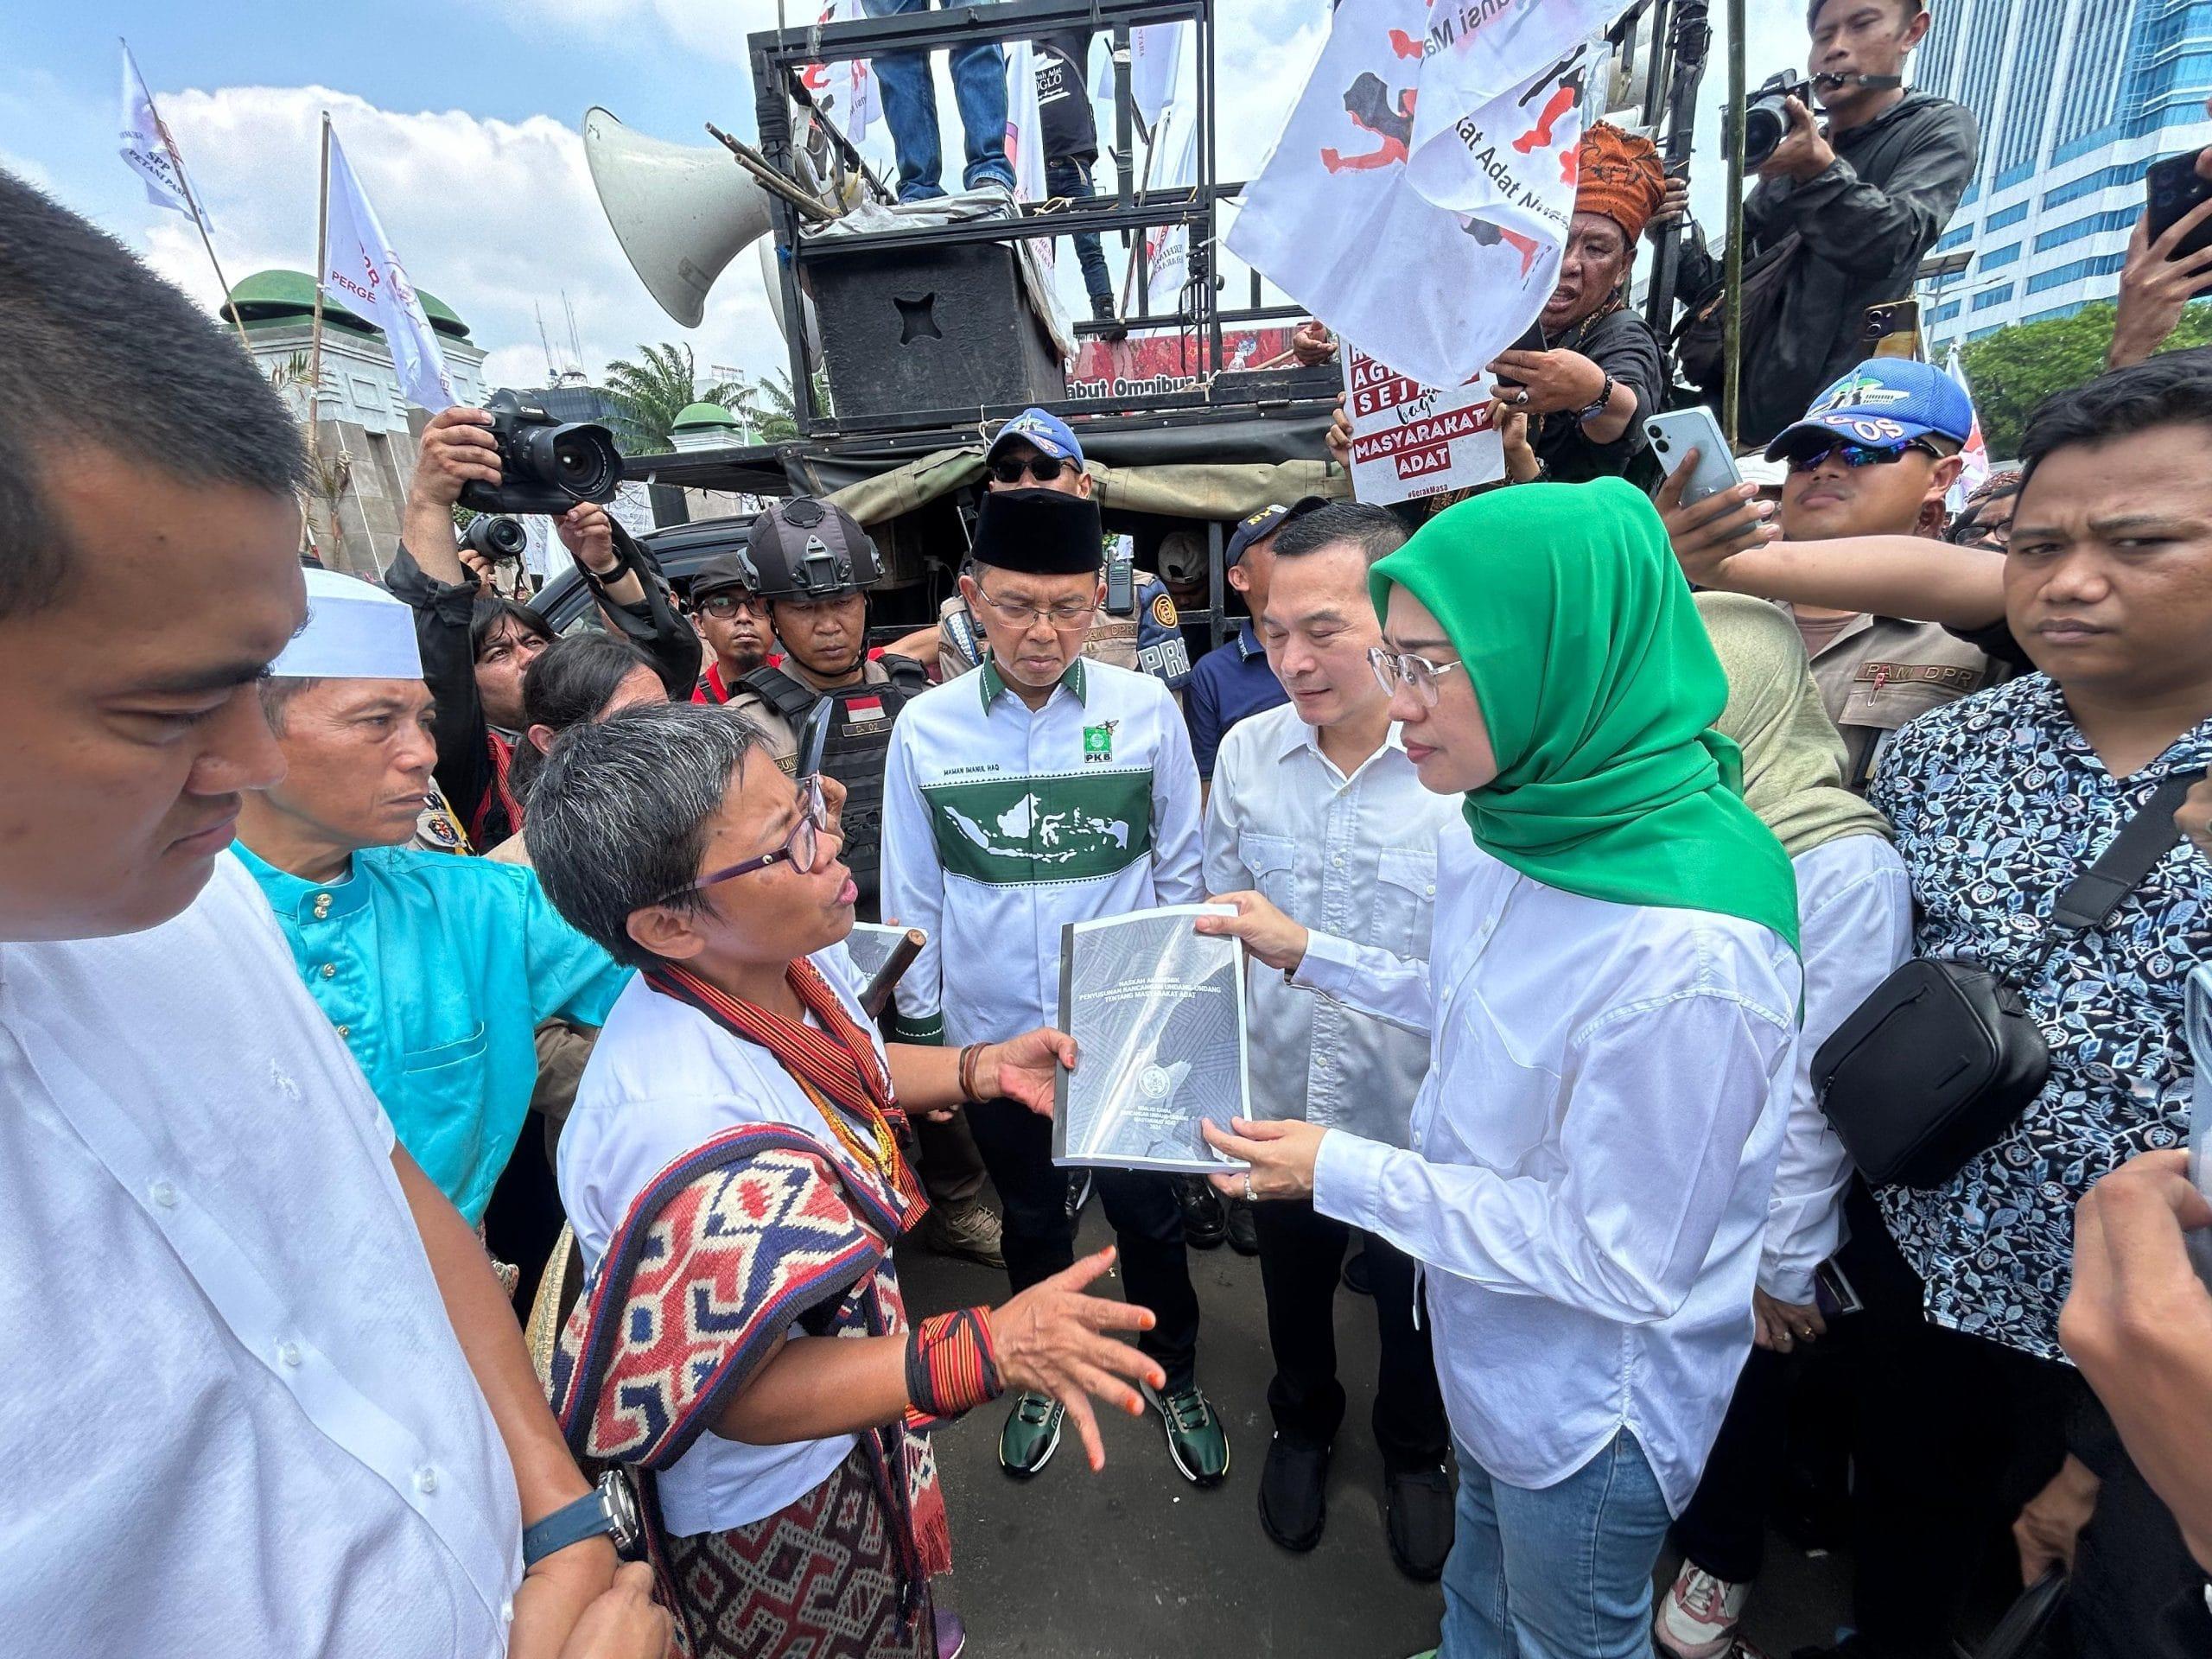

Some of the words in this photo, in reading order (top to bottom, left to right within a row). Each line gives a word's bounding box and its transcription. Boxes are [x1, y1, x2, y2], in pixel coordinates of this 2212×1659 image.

[129, 149, 165, 180] PETANI
[146, 151, 171, 170] SPP
[1475, 146, 1521, 199] Adat
[332, 270, 377, 304] PERGE
[1396, 388, 1438, 424] bagi
[1355, 408, 1485, 459] MASYARAKAT
[1398, 448, 1447, 475] ADAT
[1111, 624, 1135, 635] DPR
[1924, 666, 1974, 688] DPR
[1086, 753, 1111, 762] PKB
